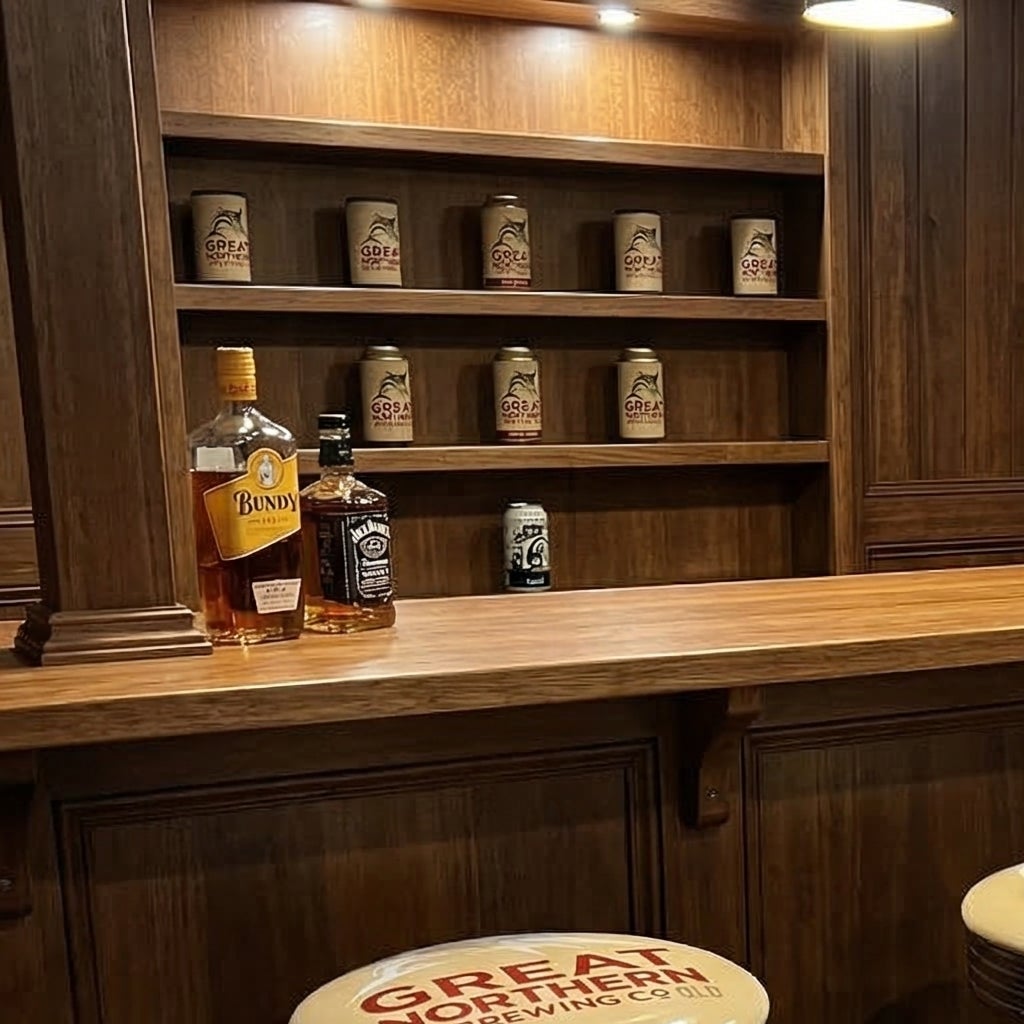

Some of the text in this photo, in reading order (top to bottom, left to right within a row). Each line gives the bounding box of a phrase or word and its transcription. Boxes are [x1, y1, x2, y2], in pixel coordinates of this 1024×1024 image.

[233, 489, 298, 516] BUNDY
[360, 948, 671, 1014] GREAT
[675, 985, 723, 999] QLD
